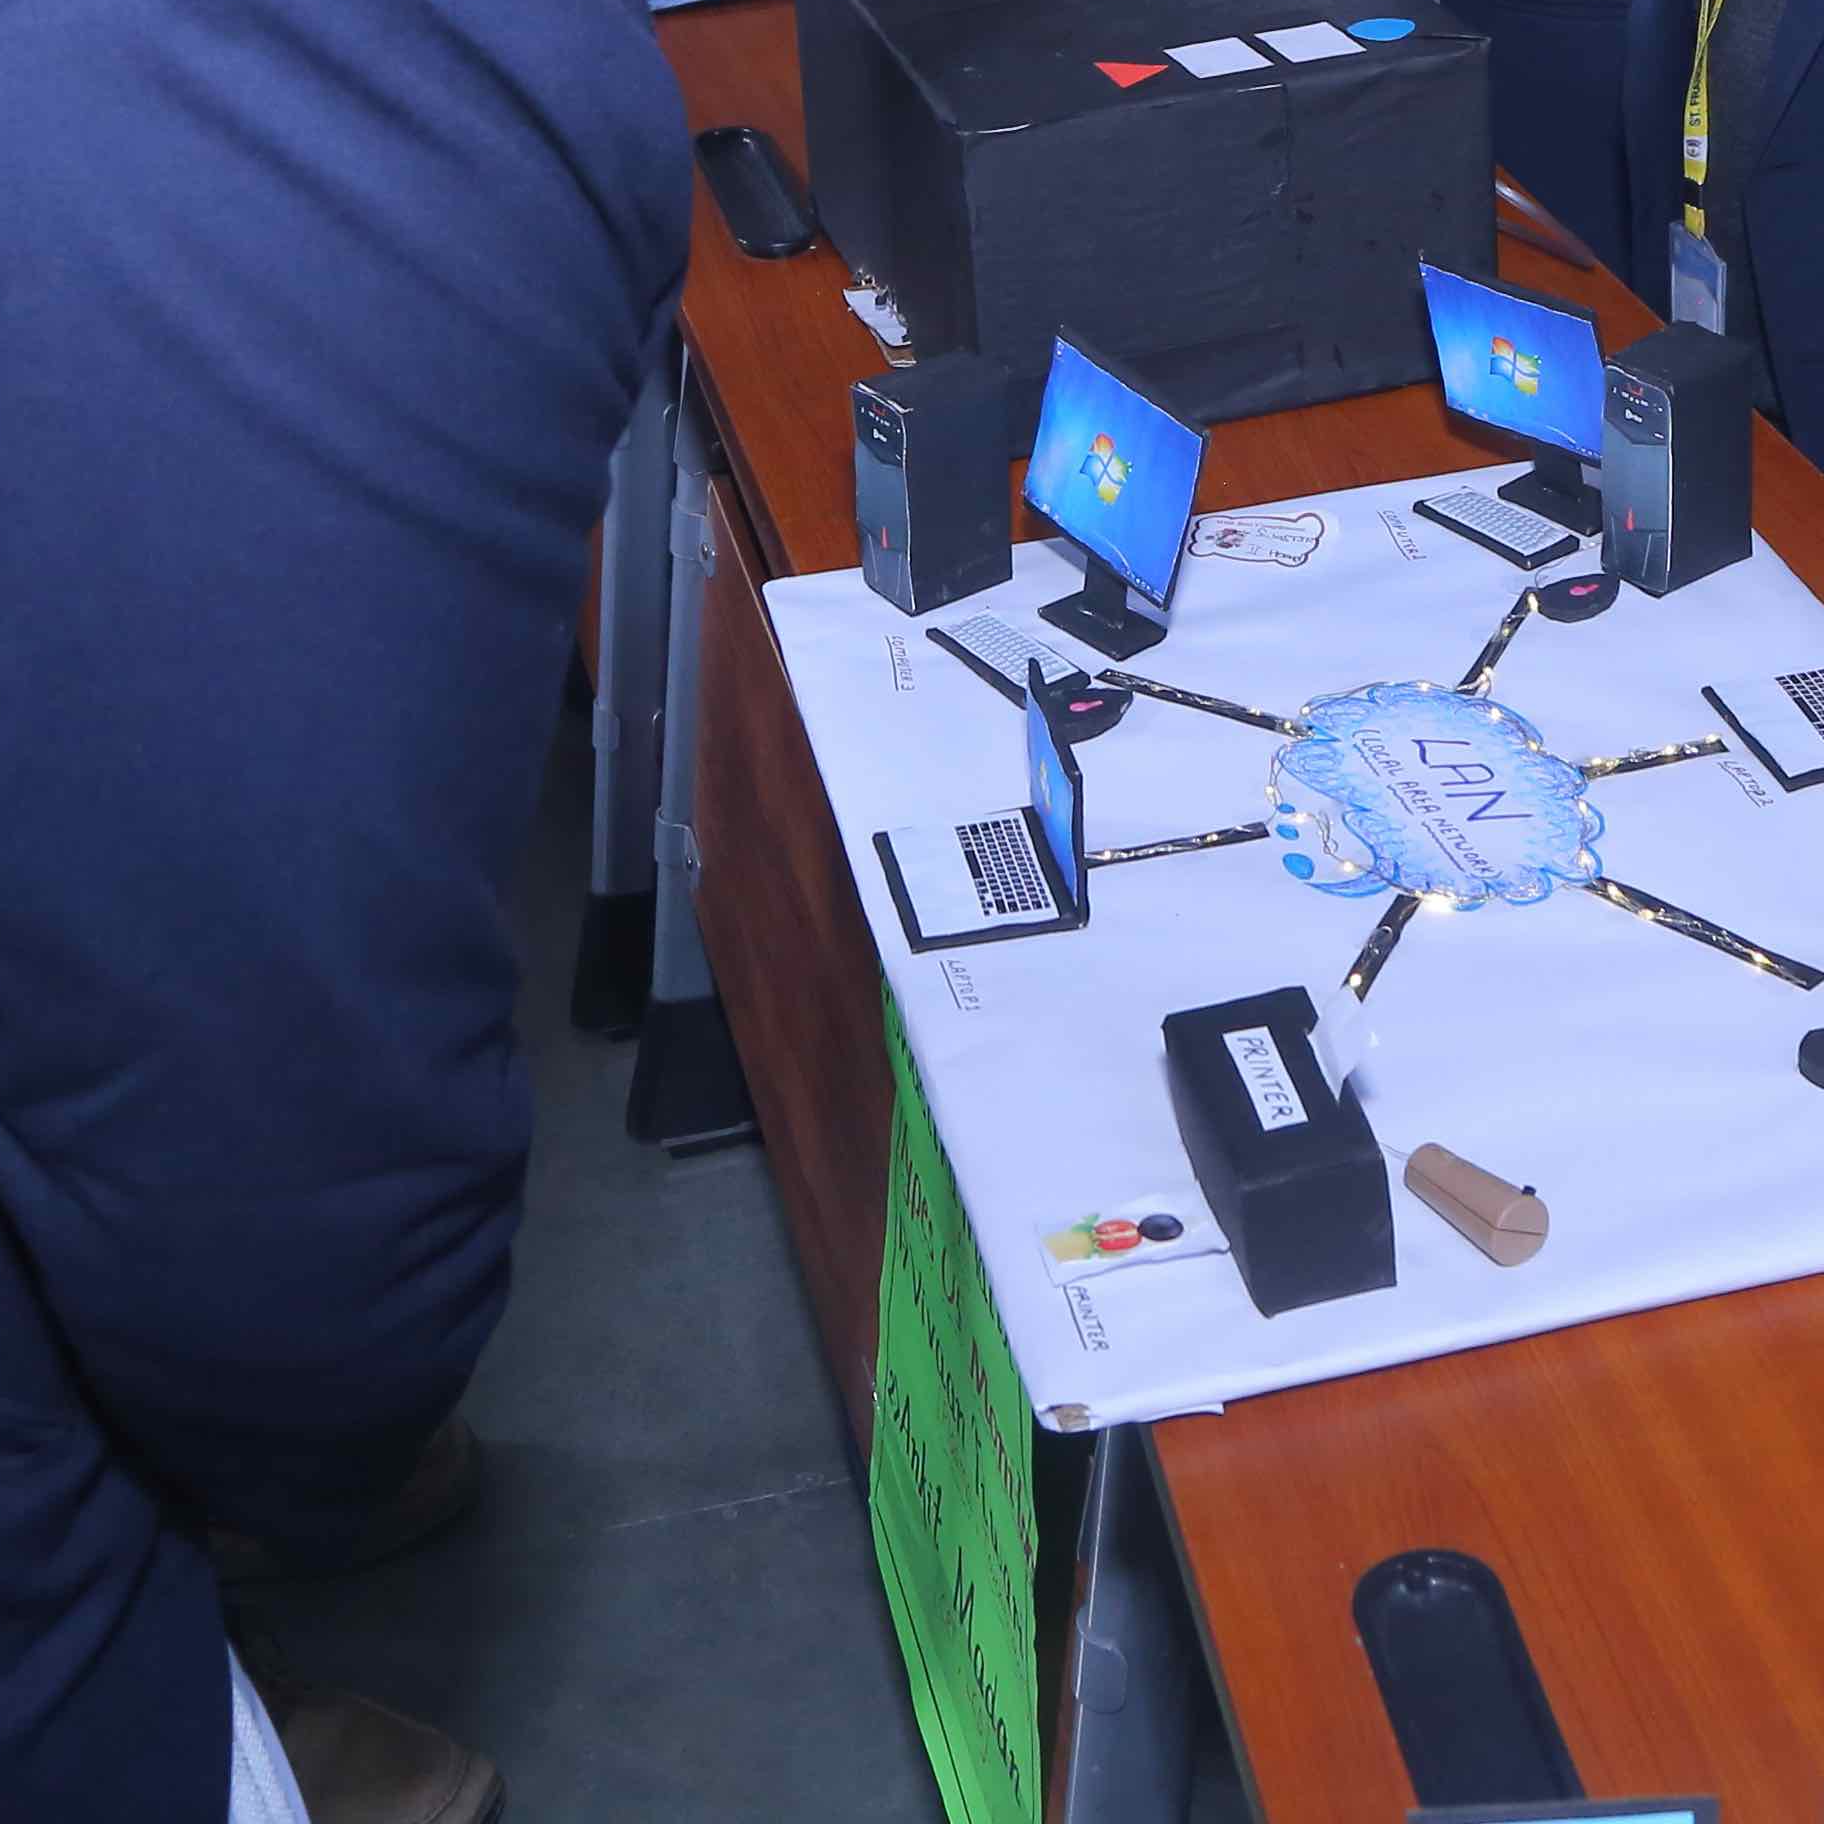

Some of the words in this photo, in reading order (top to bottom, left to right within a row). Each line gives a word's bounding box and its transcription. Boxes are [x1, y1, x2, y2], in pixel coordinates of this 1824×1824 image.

[1395, 780, 1441, 815] AREA
[1411, 739, 1533, 821] LAN
[1237, 1037, 1294, 1121] PRINTER
[1068, 1285, 1110, 1353] PRINTER
[953, 1544, 1022, 1808] Madan
